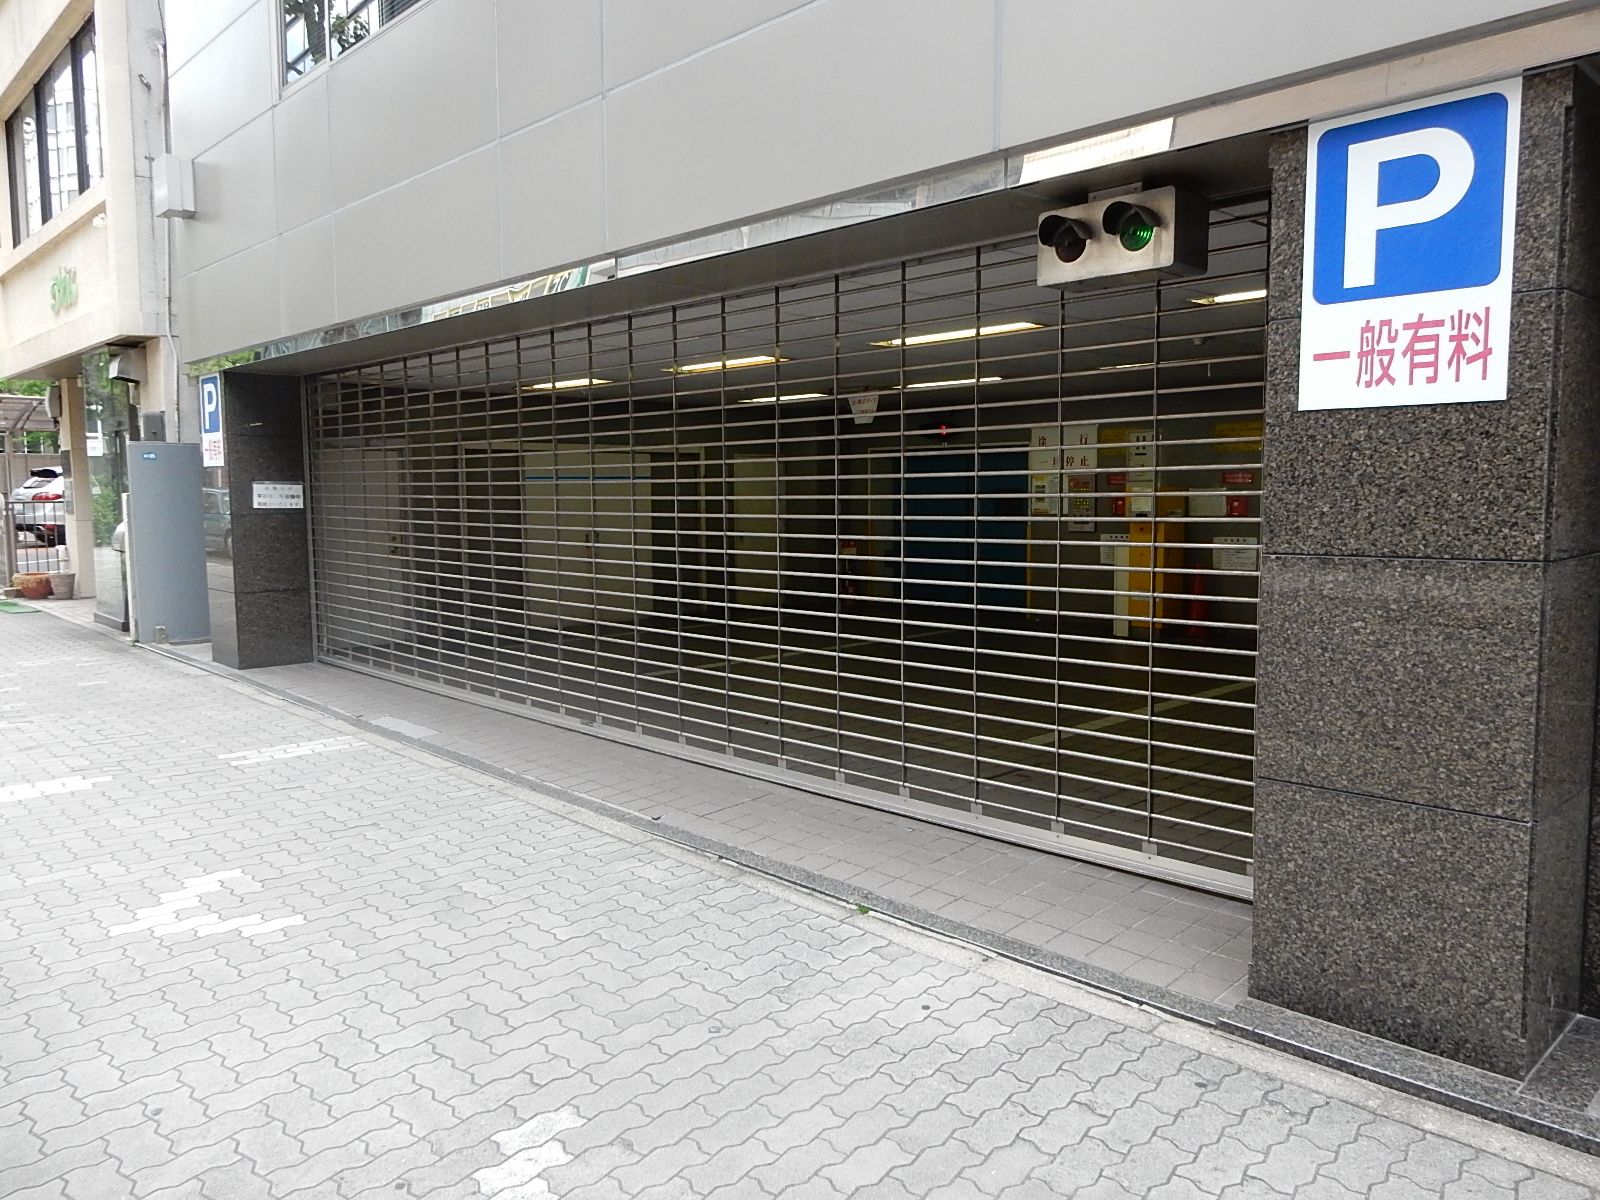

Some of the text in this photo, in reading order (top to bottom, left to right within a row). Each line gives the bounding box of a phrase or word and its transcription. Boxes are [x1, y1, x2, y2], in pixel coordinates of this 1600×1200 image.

[1343, 127, 1475, 289] P
[1313, 306, 1493, 389] 一般有料
[203, 383, 217, 429] P
